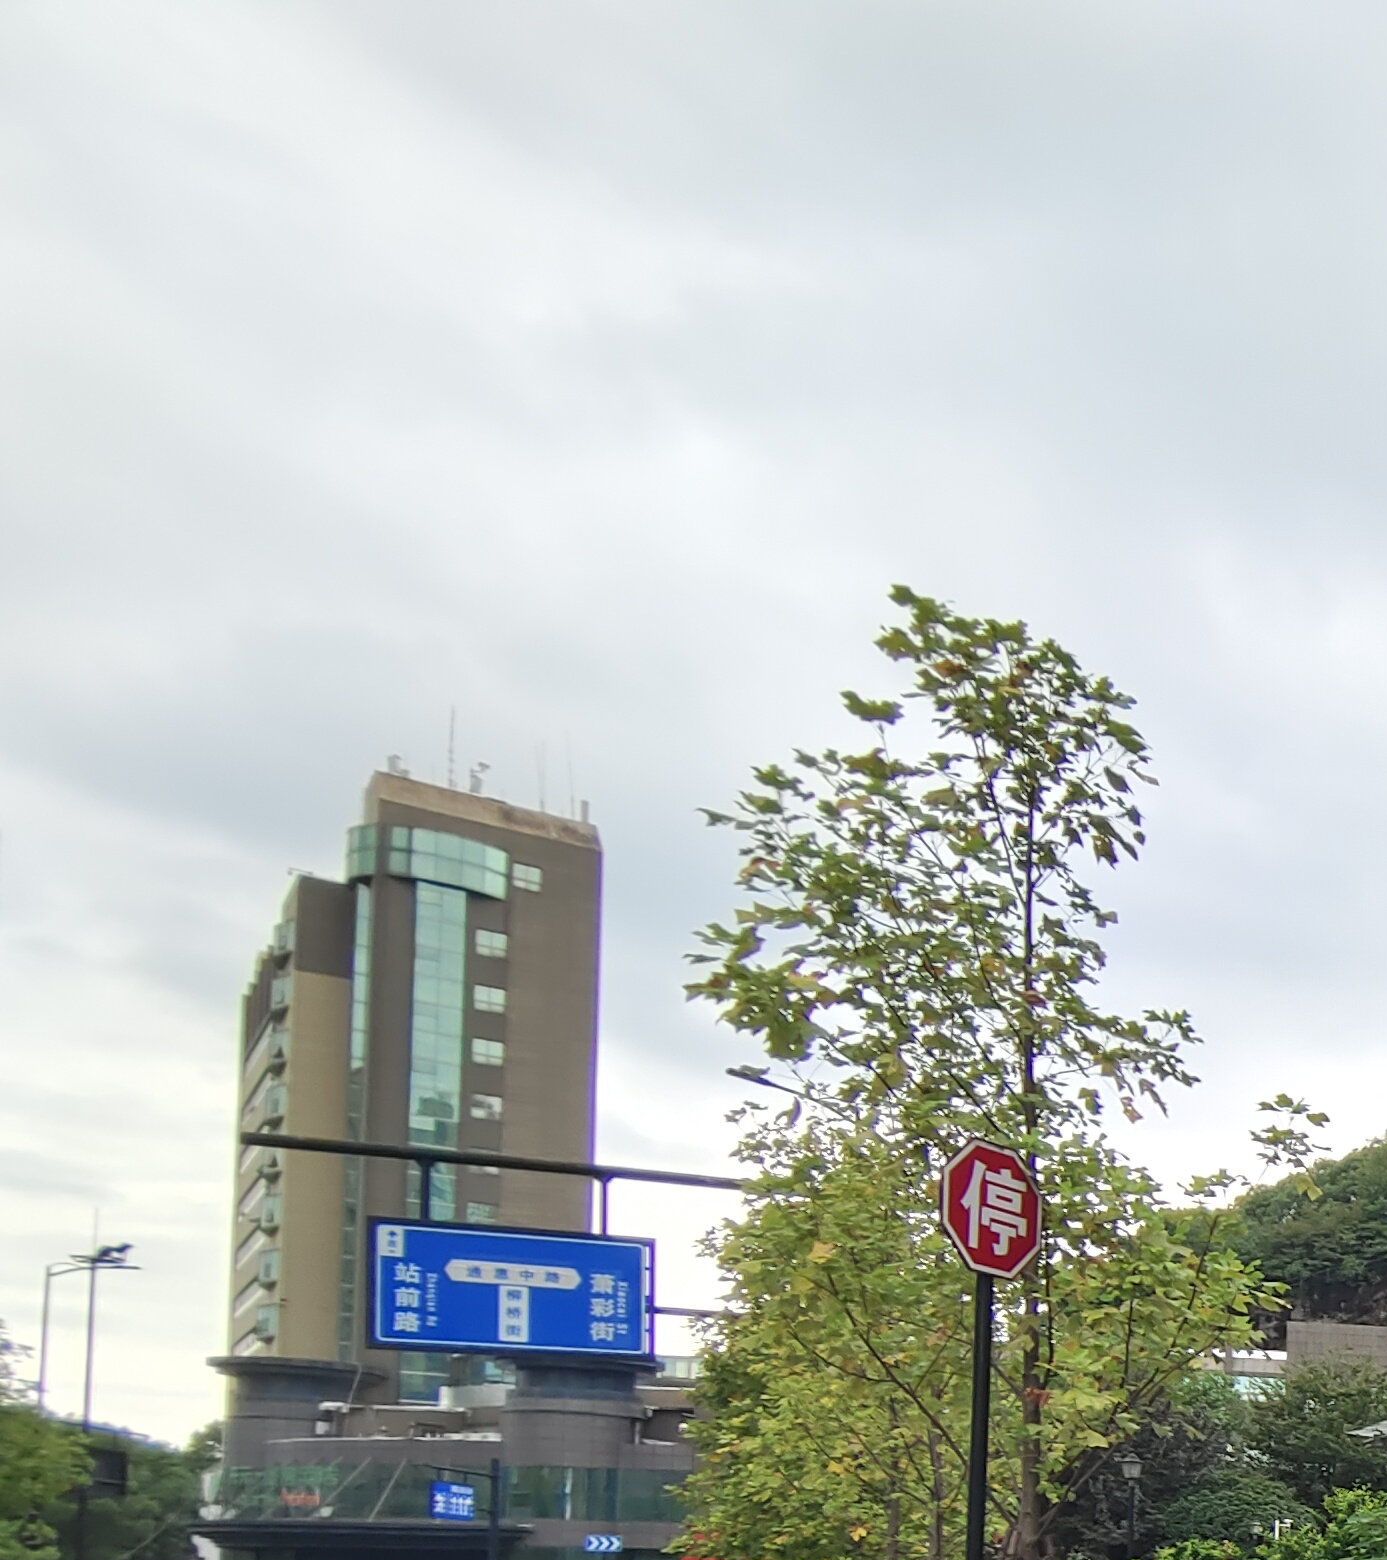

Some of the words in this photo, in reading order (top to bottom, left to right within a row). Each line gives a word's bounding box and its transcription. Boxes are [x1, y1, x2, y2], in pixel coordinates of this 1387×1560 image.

[960, 1159, 1028, 1257] 停
[393, 1262, 422, 1333] 站前路
[589, 1273, 615, 1342] 萧彩街
